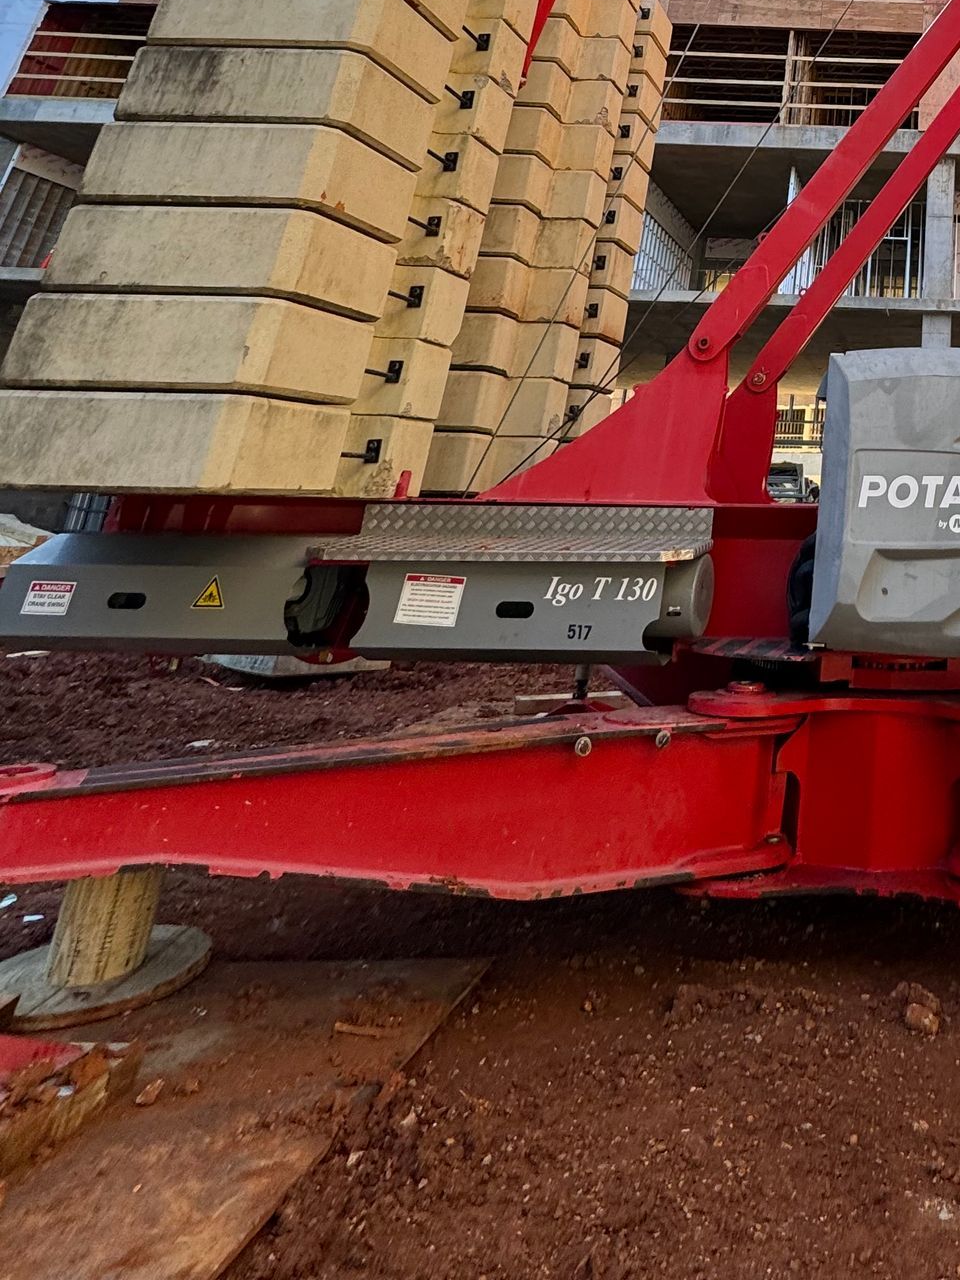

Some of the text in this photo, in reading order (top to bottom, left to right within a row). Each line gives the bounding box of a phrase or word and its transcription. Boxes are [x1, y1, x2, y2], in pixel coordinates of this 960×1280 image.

[938, 520, 948, 530] by
[543, 576, 658, 606] Igo T 130
[567, 624, 593, 640] 517
